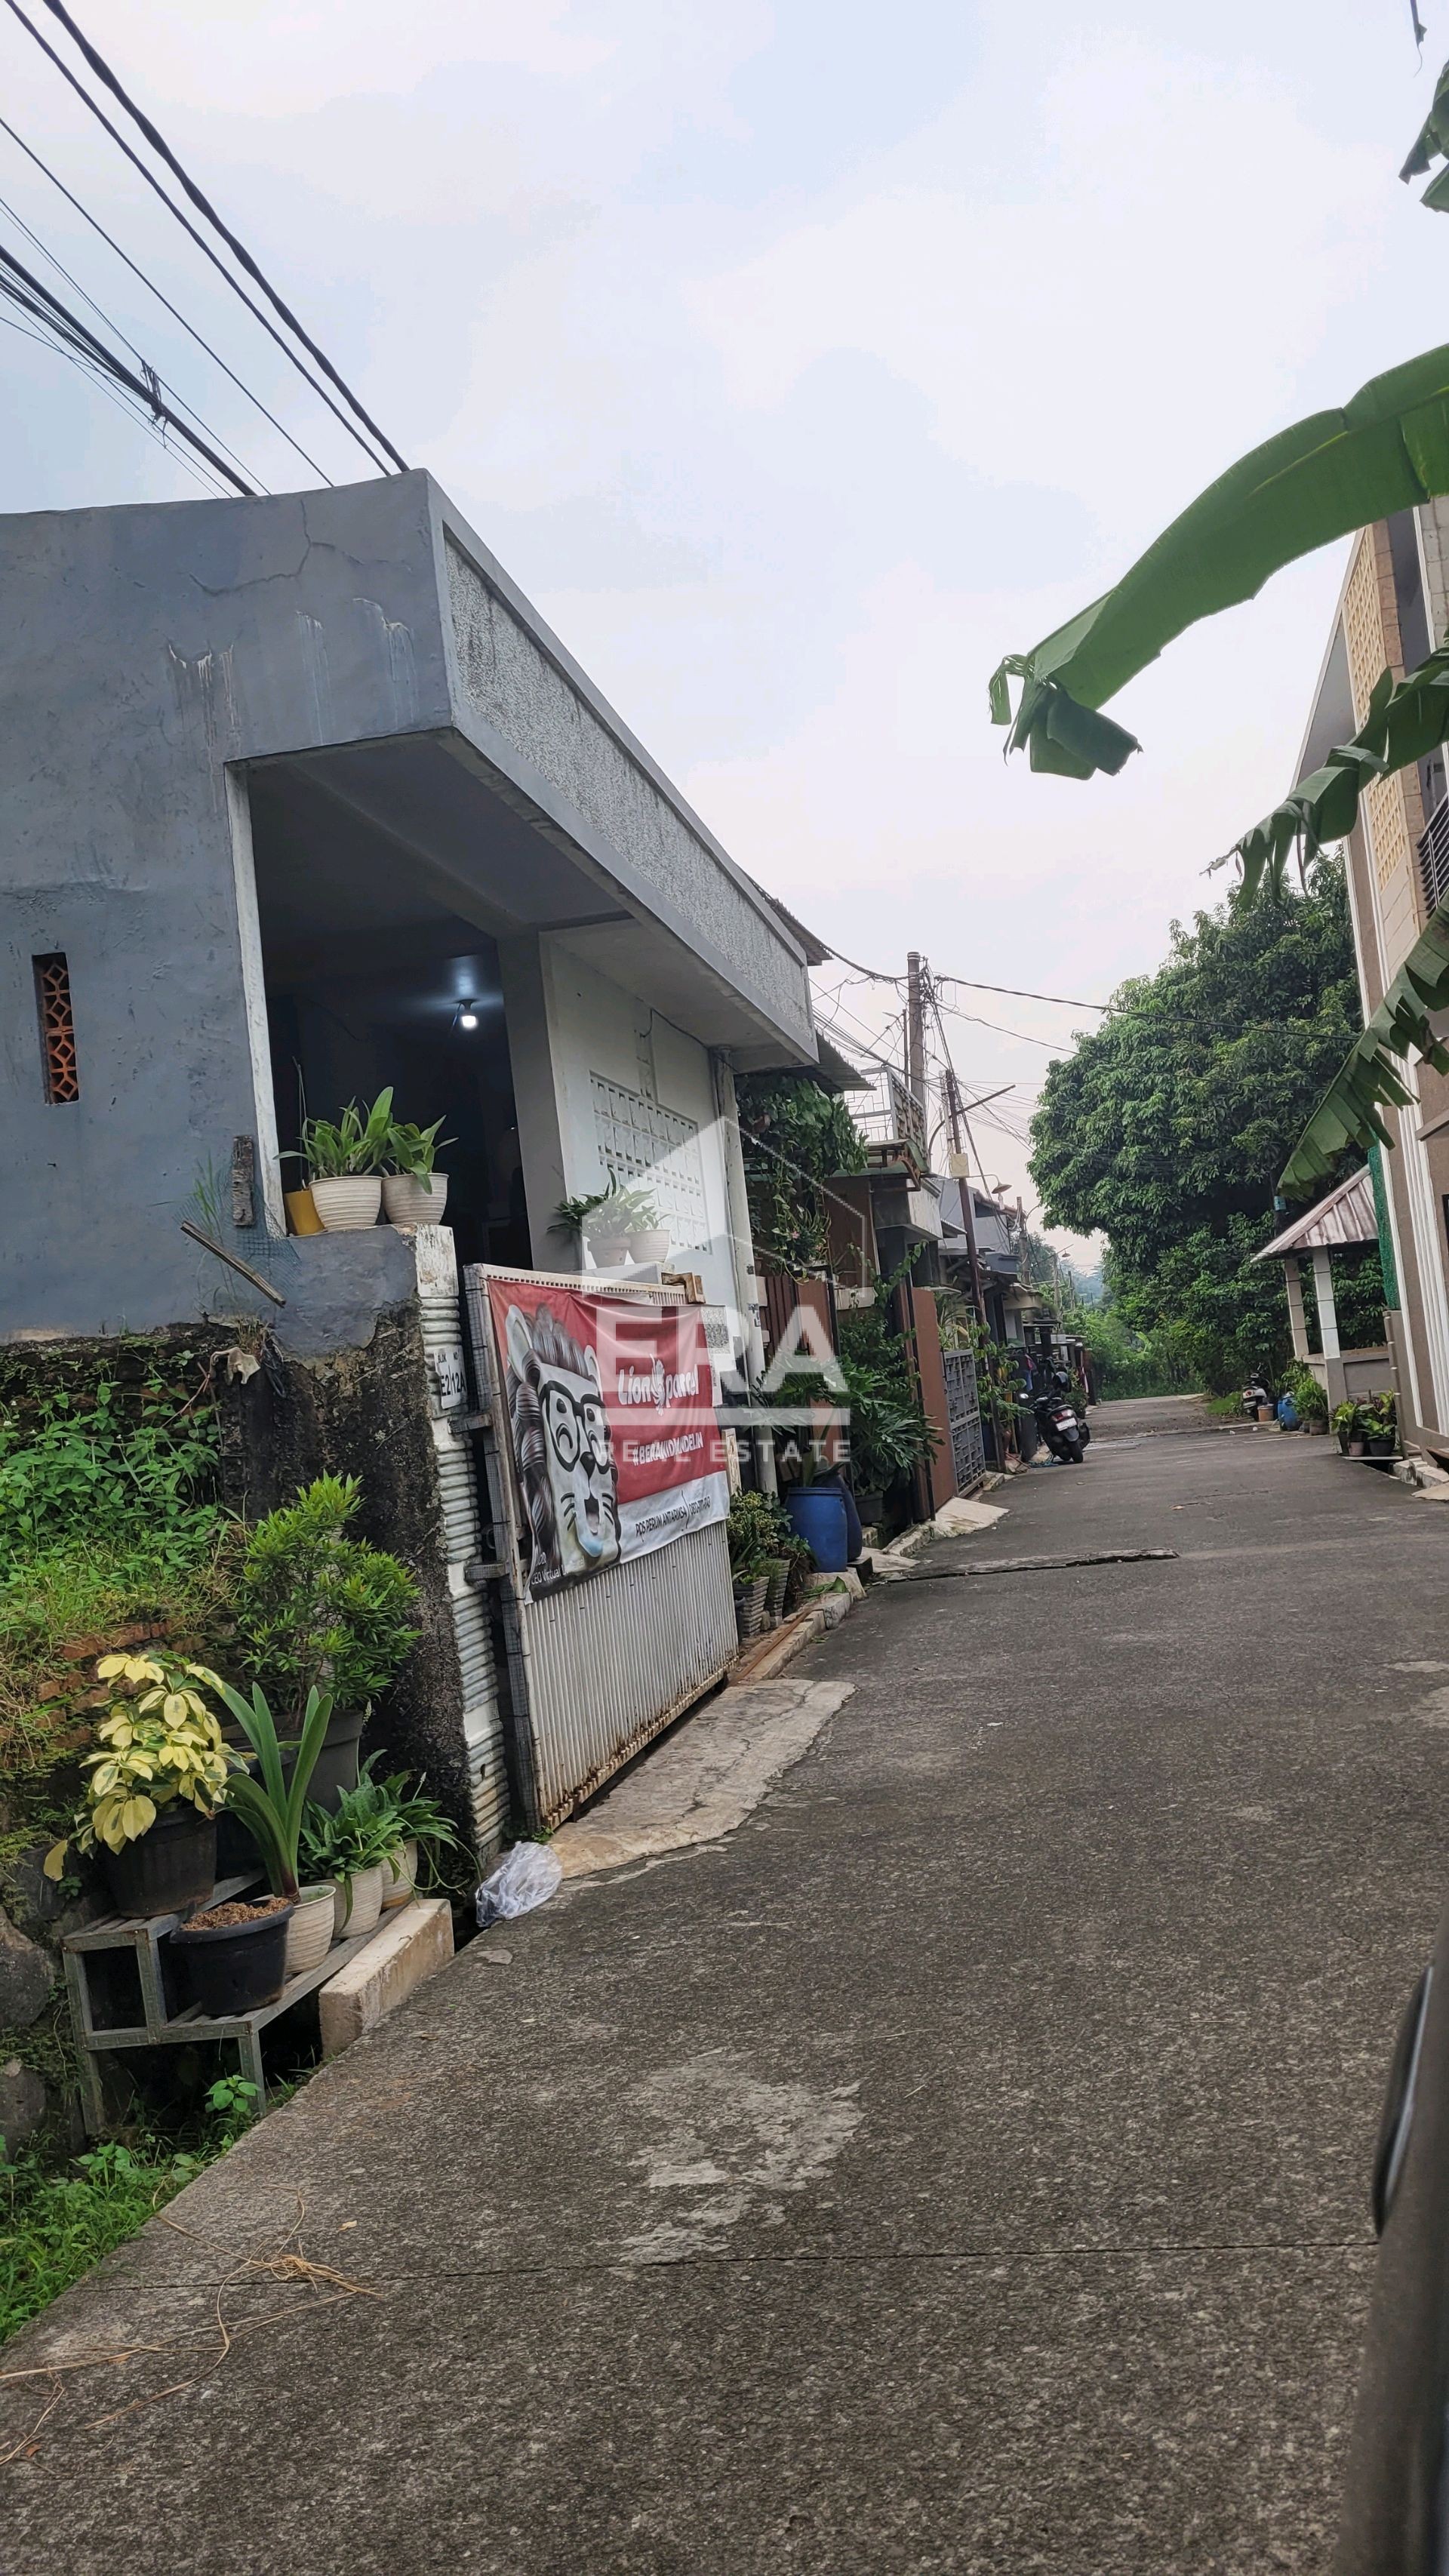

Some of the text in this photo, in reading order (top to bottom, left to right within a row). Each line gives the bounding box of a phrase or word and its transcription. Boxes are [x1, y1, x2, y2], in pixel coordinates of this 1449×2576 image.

[440, 1374, 451, 1396] E2
[618, 1364, 700, 1408] Lion parcel
